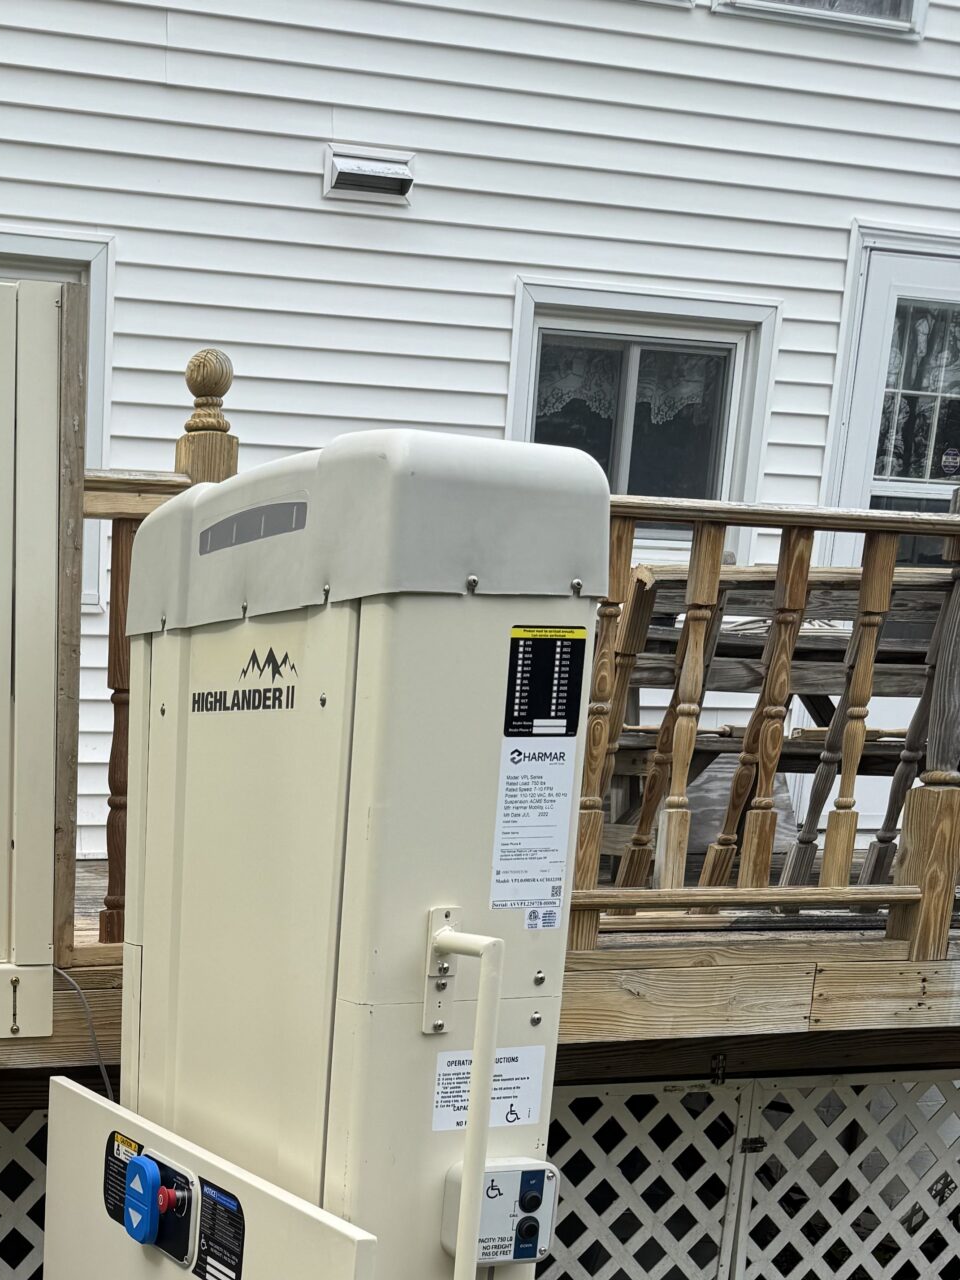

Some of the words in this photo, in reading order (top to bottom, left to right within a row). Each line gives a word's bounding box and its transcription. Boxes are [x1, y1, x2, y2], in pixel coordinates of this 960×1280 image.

[192, 687, 283, 712] HIGHLANDER
[285, 685, 295, 709] II
[523, 751, 566, 762] HARMAR
[447, 1059, 473, 1067] OPERATIN
[495, 1056, 519, 1064] UCTIONS
